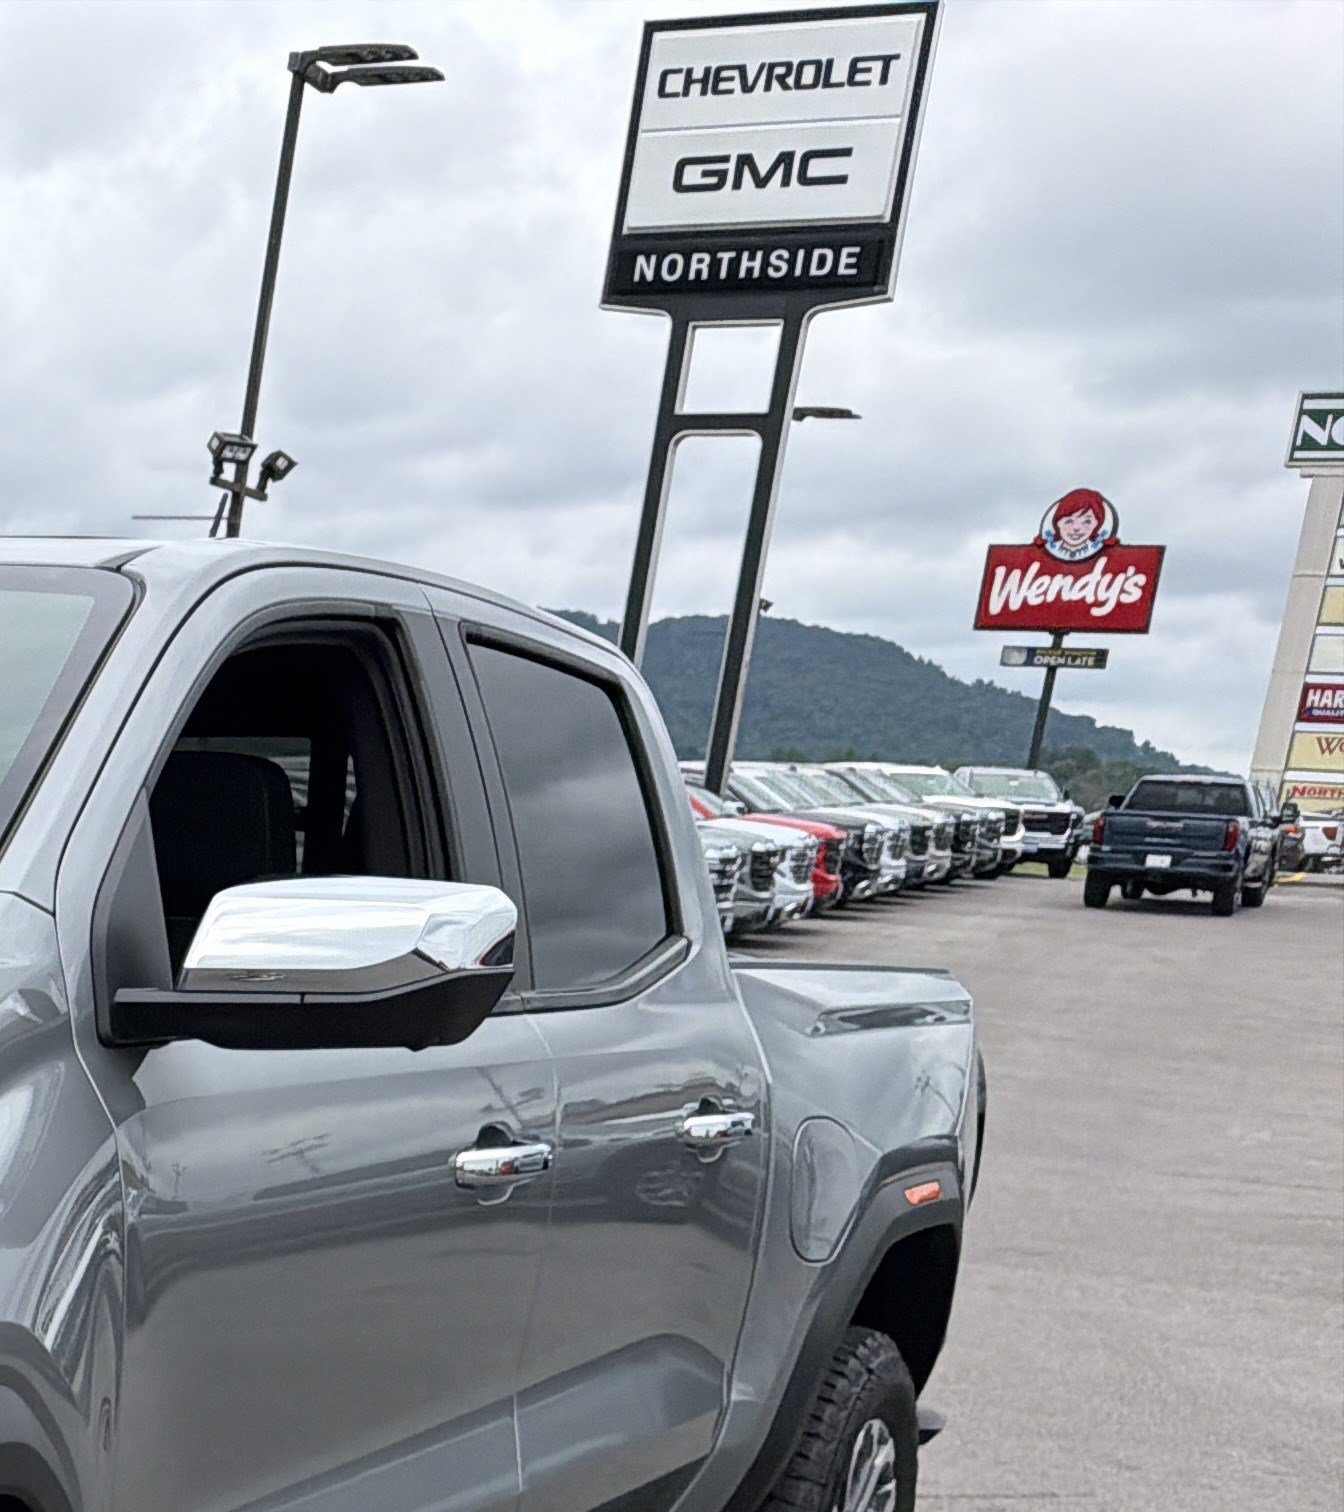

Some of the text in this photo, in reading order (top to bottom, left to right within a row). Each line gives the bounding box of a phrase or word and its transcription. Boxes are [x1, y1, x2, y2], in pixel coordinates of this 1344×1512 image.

[657, 53, 902, 99] CHEVROLET
[672, 146, 854, 194] GMC
[633, 246, 861, 283] NORTHSIDE
[988, 556, 1147, 617] Wendy's
